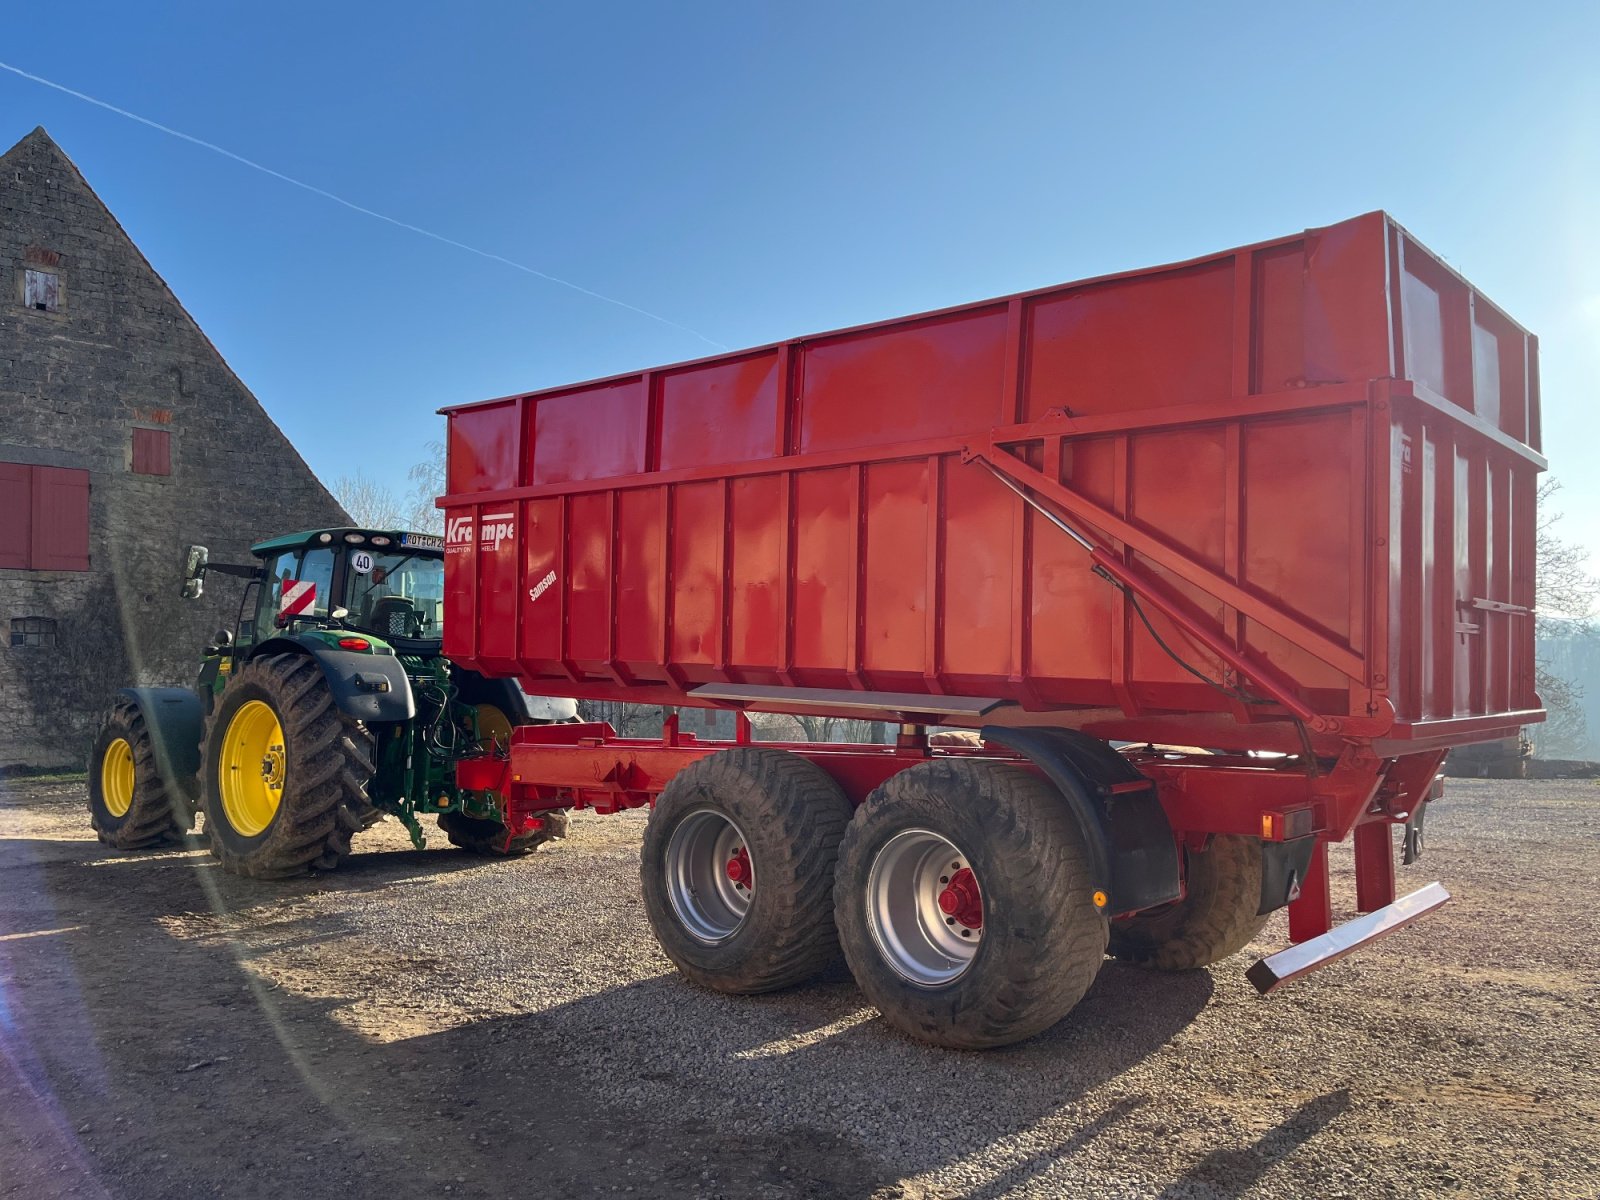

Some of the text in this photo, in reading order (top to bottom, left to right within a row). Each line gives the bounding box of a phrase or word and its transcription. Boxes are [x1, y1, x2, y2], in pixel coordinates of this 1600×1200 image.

[407, 534, 422, 545] ROT
[426, 537, 437, 547] CH
[356, 555, 370, 570] 40
[529, 570, 557, 602] Samson
